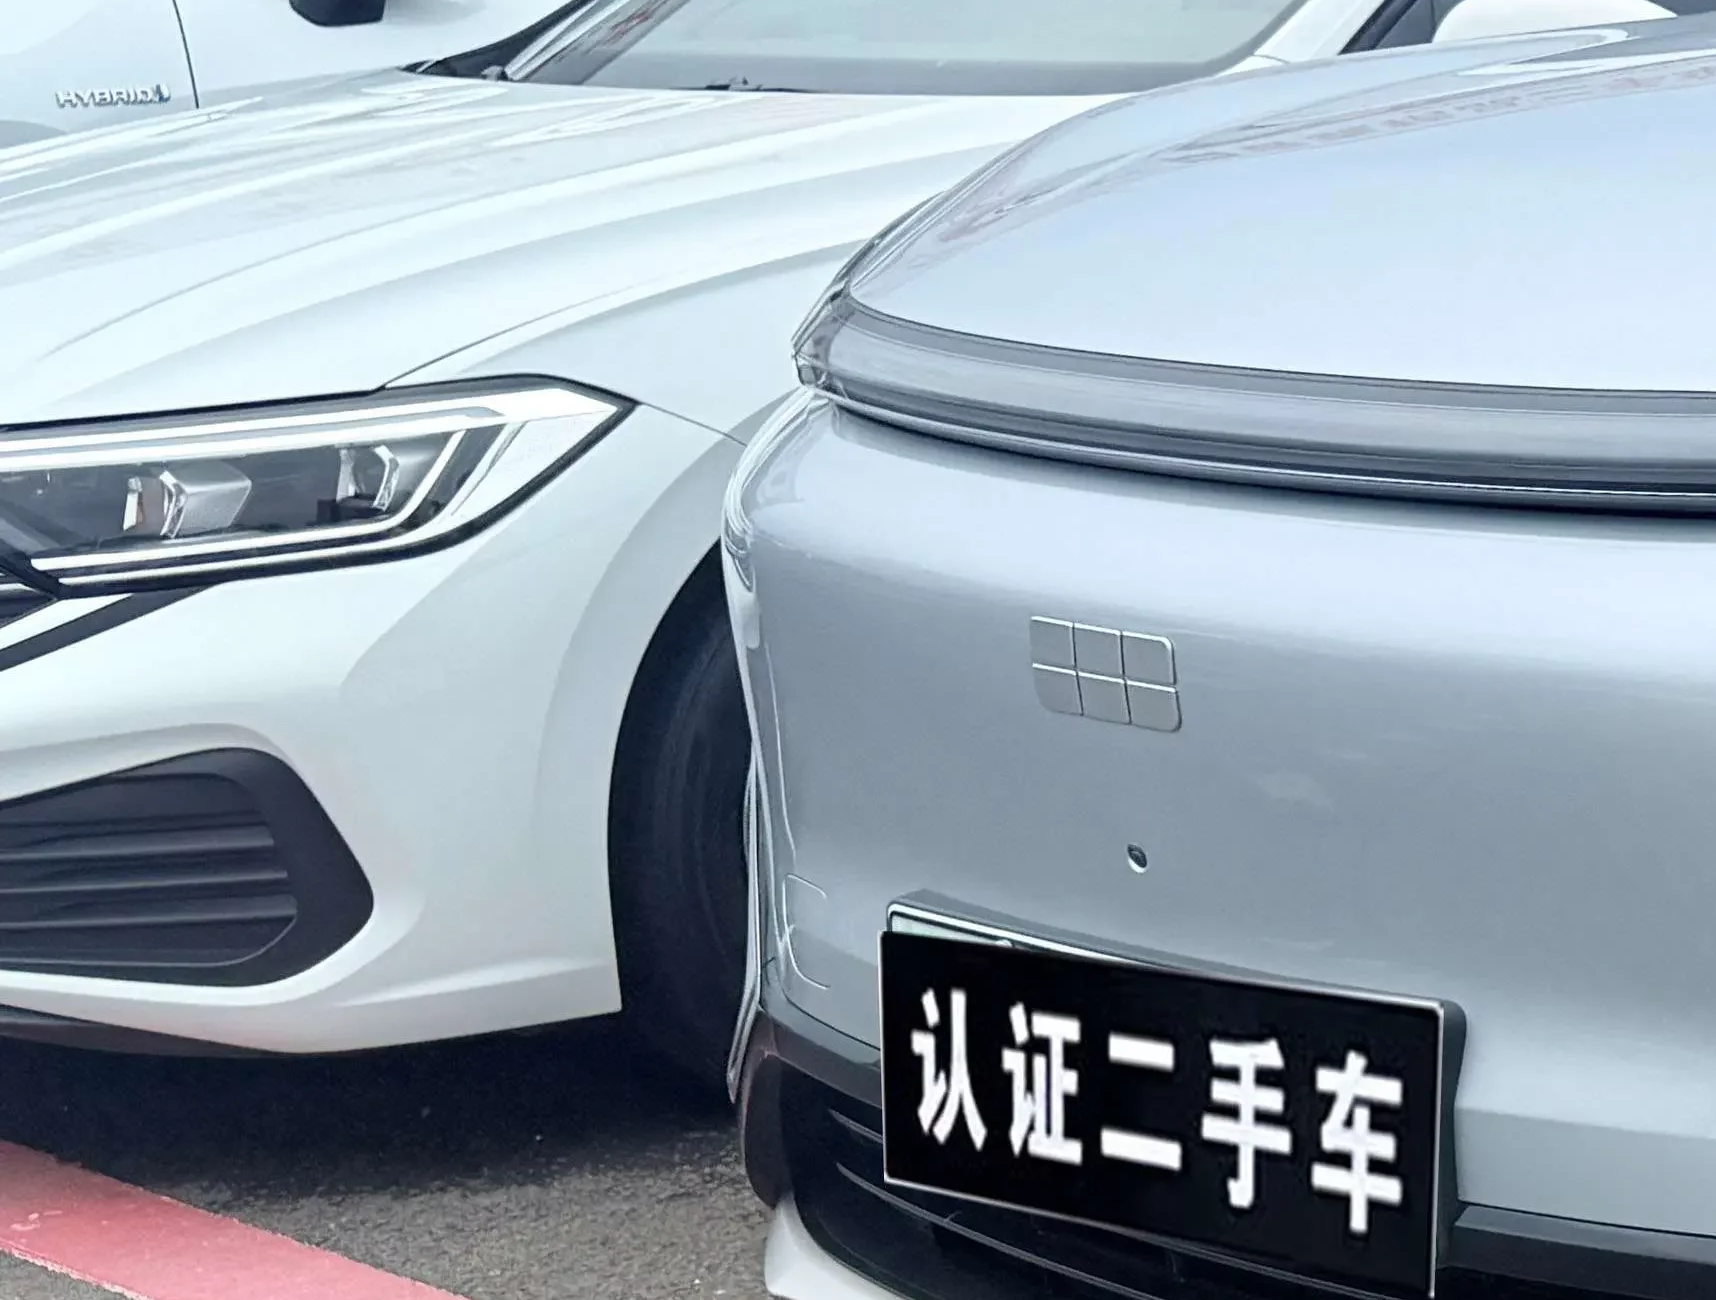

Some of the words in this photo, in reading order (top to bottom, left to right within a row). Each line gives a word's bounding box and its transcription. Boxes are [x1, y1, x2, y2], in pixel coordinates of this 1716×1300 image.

[54, 86, 152, 109] HYBRID
[909, 986, 1403, 1236] 认证二手车
